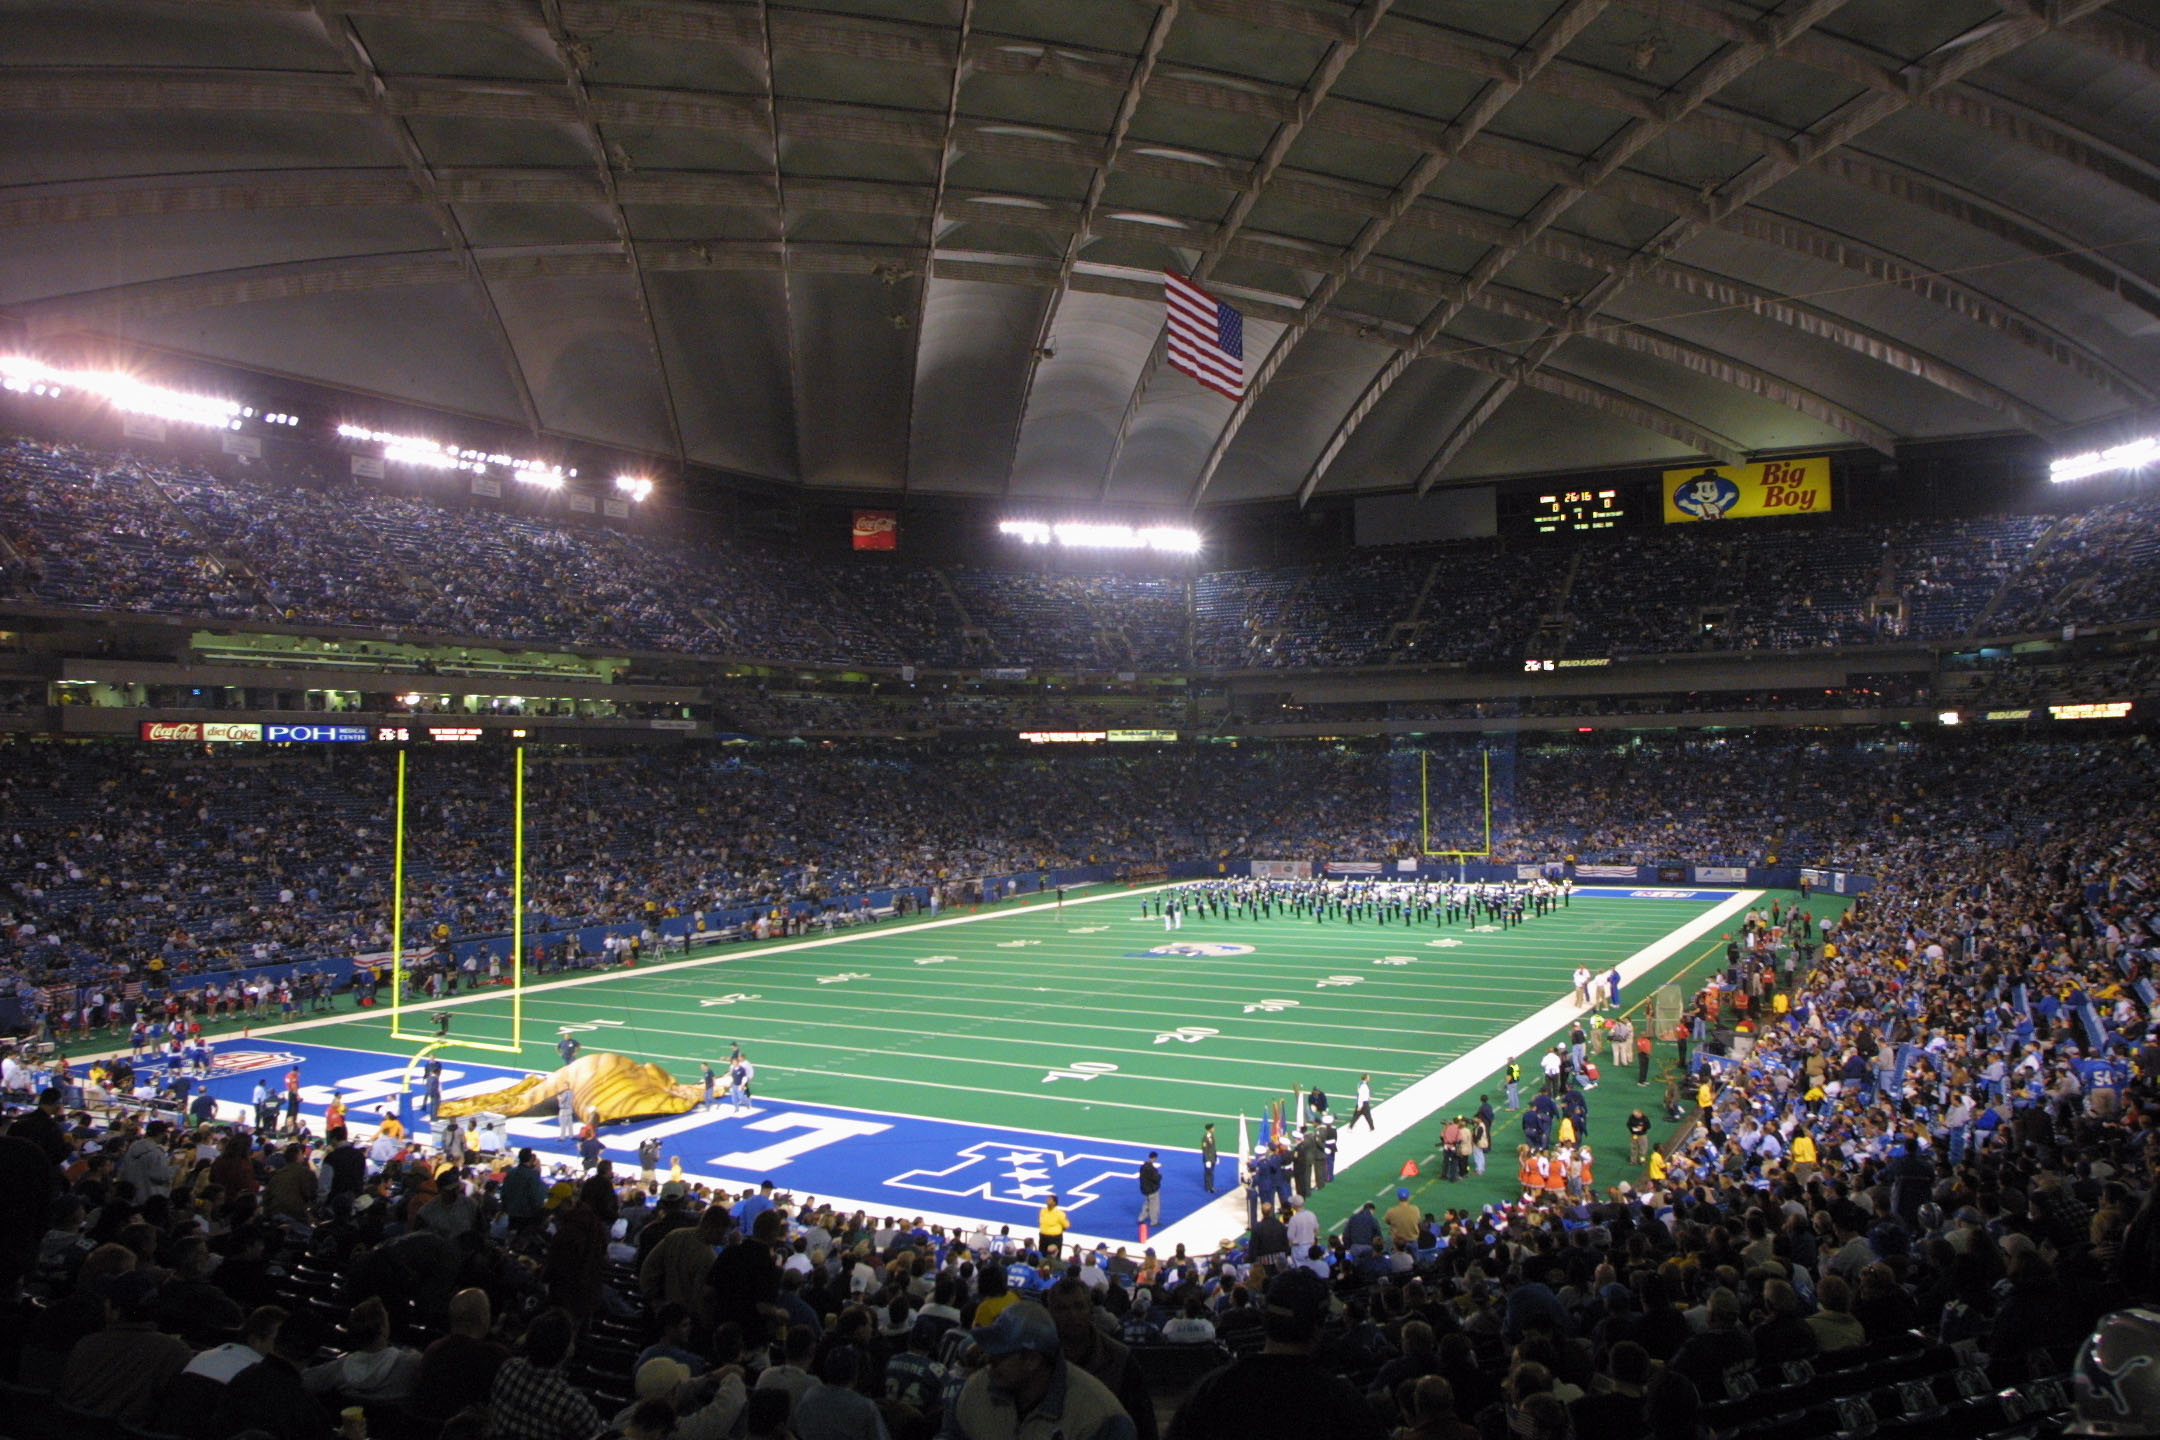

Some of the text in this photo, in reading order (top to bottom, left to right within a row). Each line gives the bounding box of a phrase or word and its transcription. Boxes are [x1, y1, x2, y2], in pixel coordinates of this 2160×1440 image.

[1760, 462, 1806, 488] Big
[1763, 486, 1816, 510] Boy
[149, 723, 198, 741] Coca-Cola
[206, 725, 258, 740] diet Coke
[268, 726, 335, 741] POH
[1153, 1026, 1220, 1044] 20
[1041, 1061, 1119, 1083] 10
